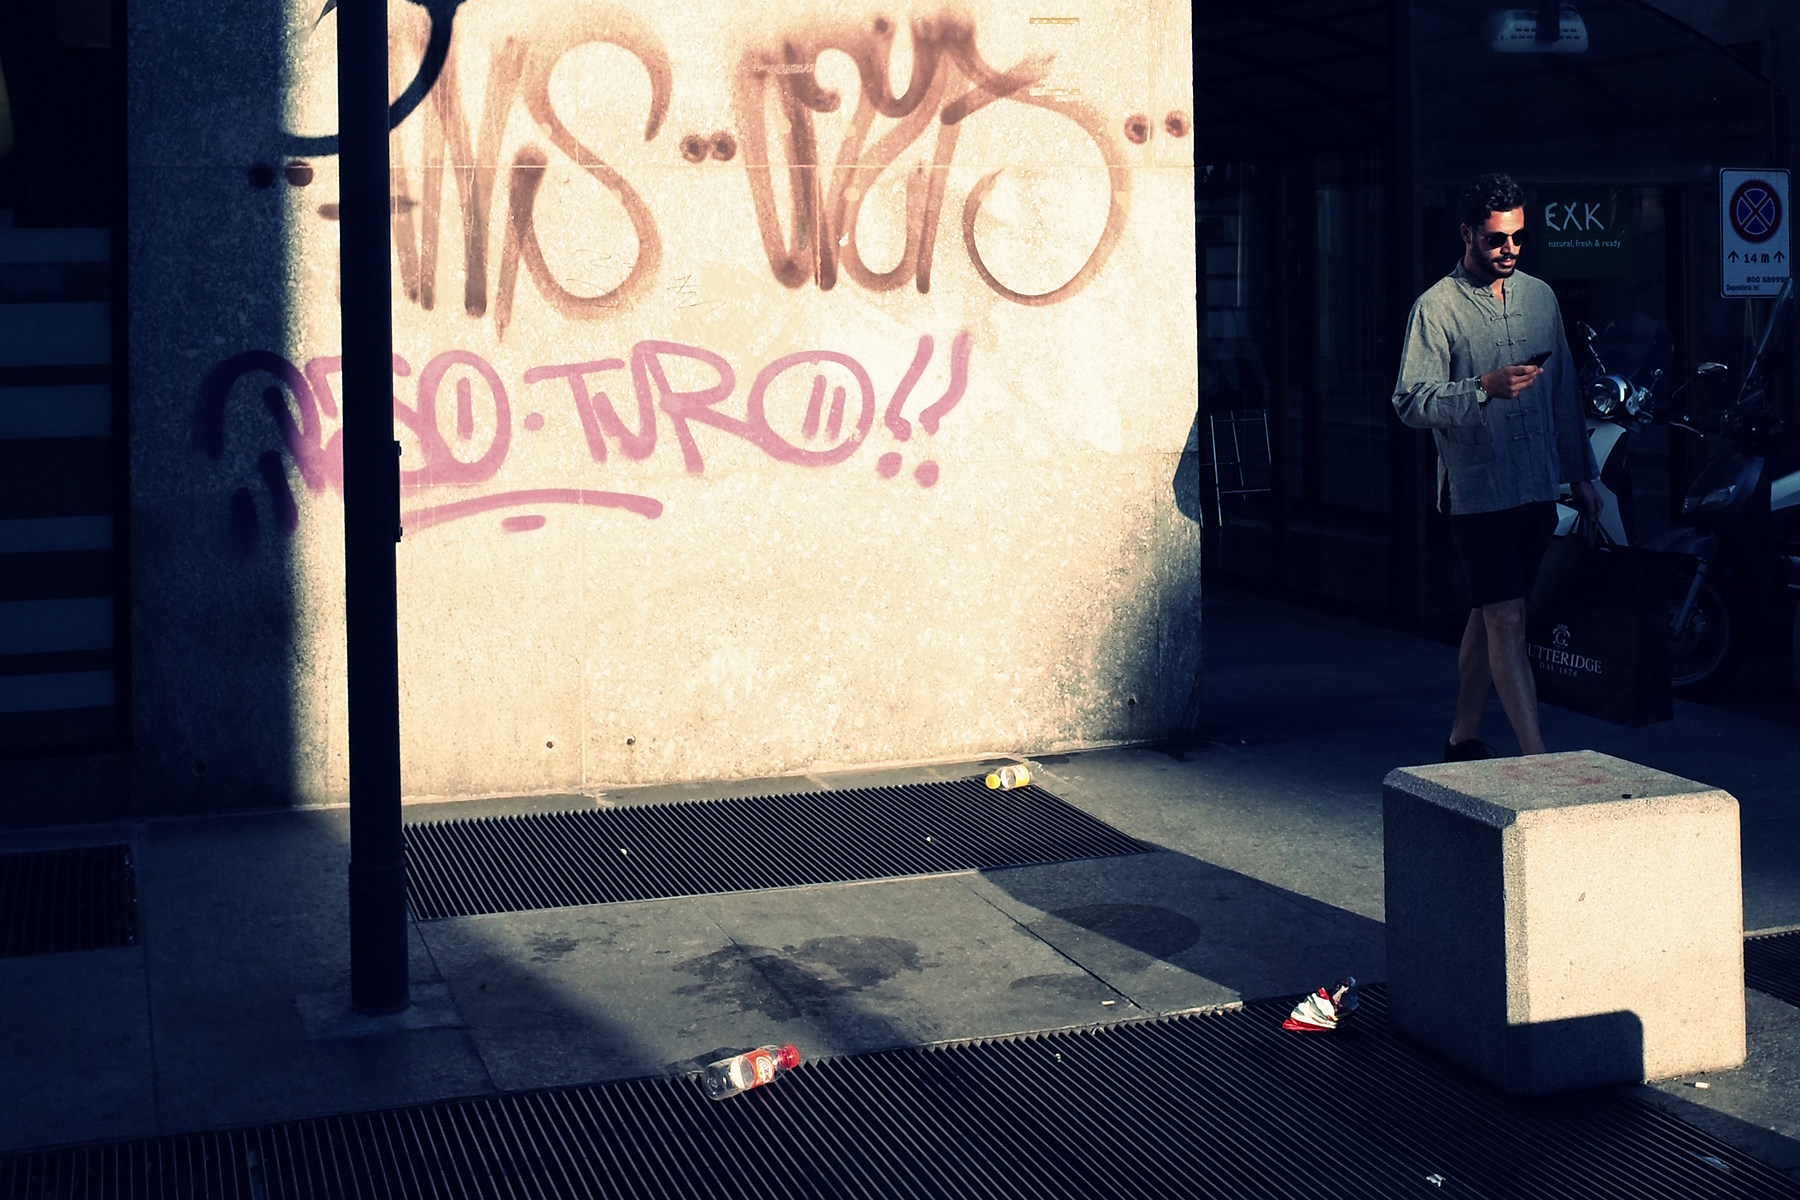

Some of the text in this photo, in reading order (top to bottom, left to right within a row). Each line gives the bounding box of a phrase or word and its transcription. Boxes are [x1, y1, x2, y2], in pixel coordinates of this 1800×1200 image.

[1545, 202, 1605, 231] EXK
[1548, 240, 1575, 248] natural,
[1575, 239, 1593, 248] fresh
[1602, 240, 1621, 249] ready
[1743, 253, 1769, 264] 14 m
[1527, 643, 1603, 674] UTTERIDGE
